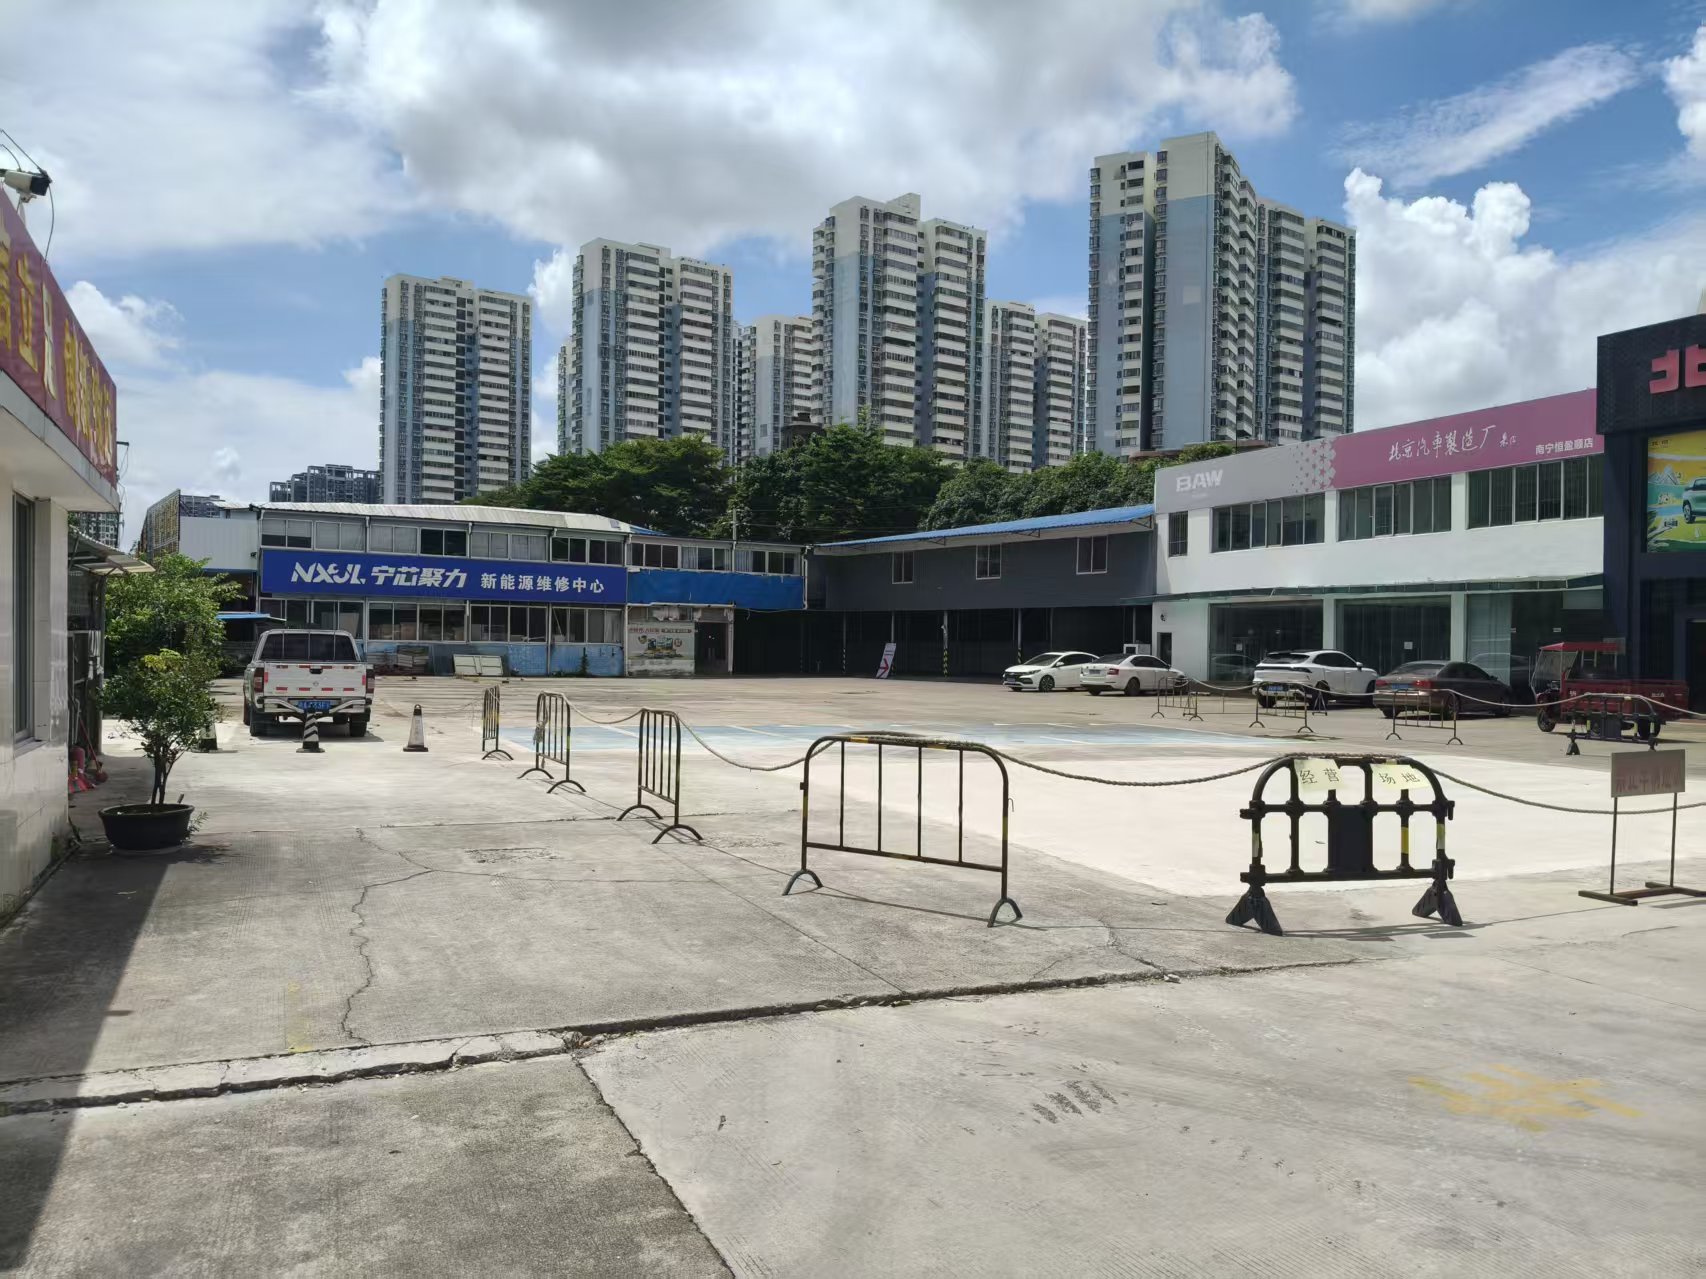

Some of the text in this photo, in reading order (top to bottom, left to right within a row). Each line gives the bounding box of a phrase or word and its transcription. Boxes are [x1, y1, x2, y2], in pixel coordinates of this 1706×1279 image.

[1176, 469, 1222, 491] BAW
[371, 565, 466, 587] 宁芯聚力
[481, 573, 605, 594] 新能源维修中心
[1299, 768, 1420, 785] 经营 场地
